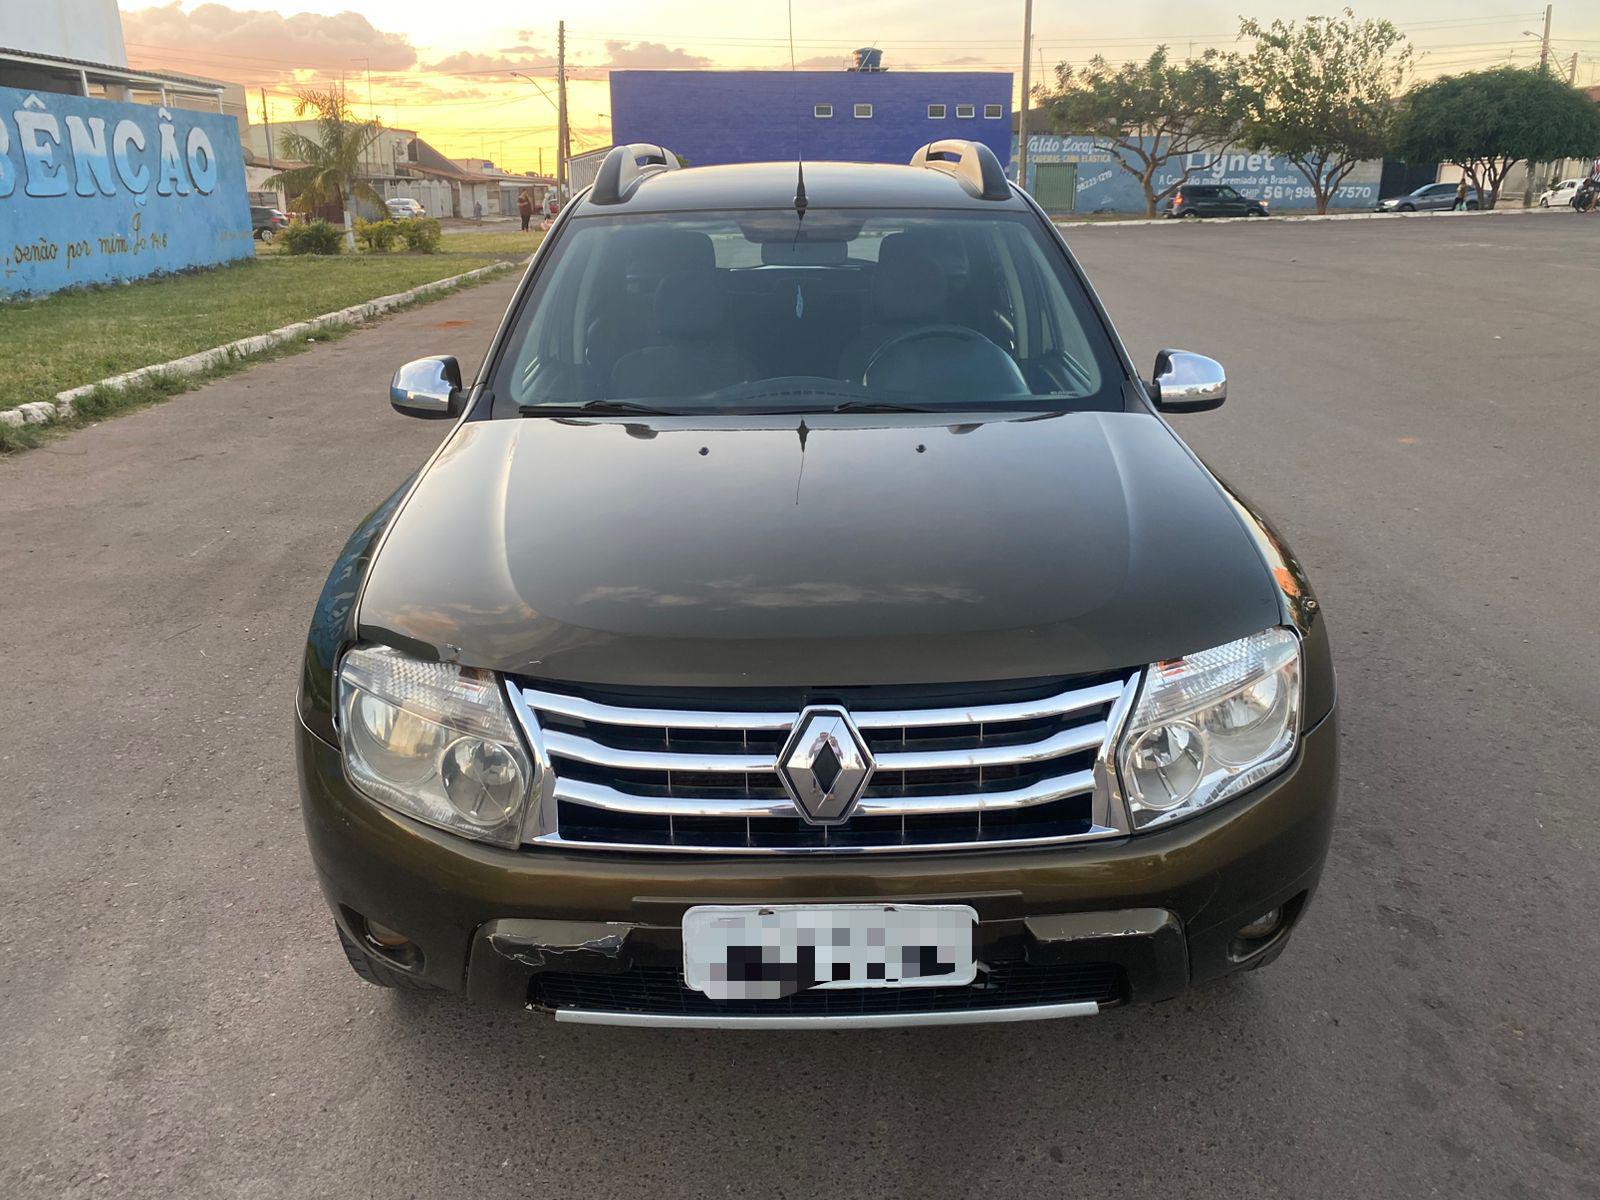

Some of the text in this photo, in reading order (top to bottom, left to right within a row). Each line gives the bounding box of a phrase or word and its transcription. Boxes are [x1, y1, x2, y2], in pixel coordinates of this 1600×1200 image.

[1158, 174, 1165, 185] A
[1221, 175, 1257, 186] premiada
[1258, 174, 1269, 185] de
[1240, 188, 1259, 198] CHIP
[1263, 186, 1283, 199] 5G
